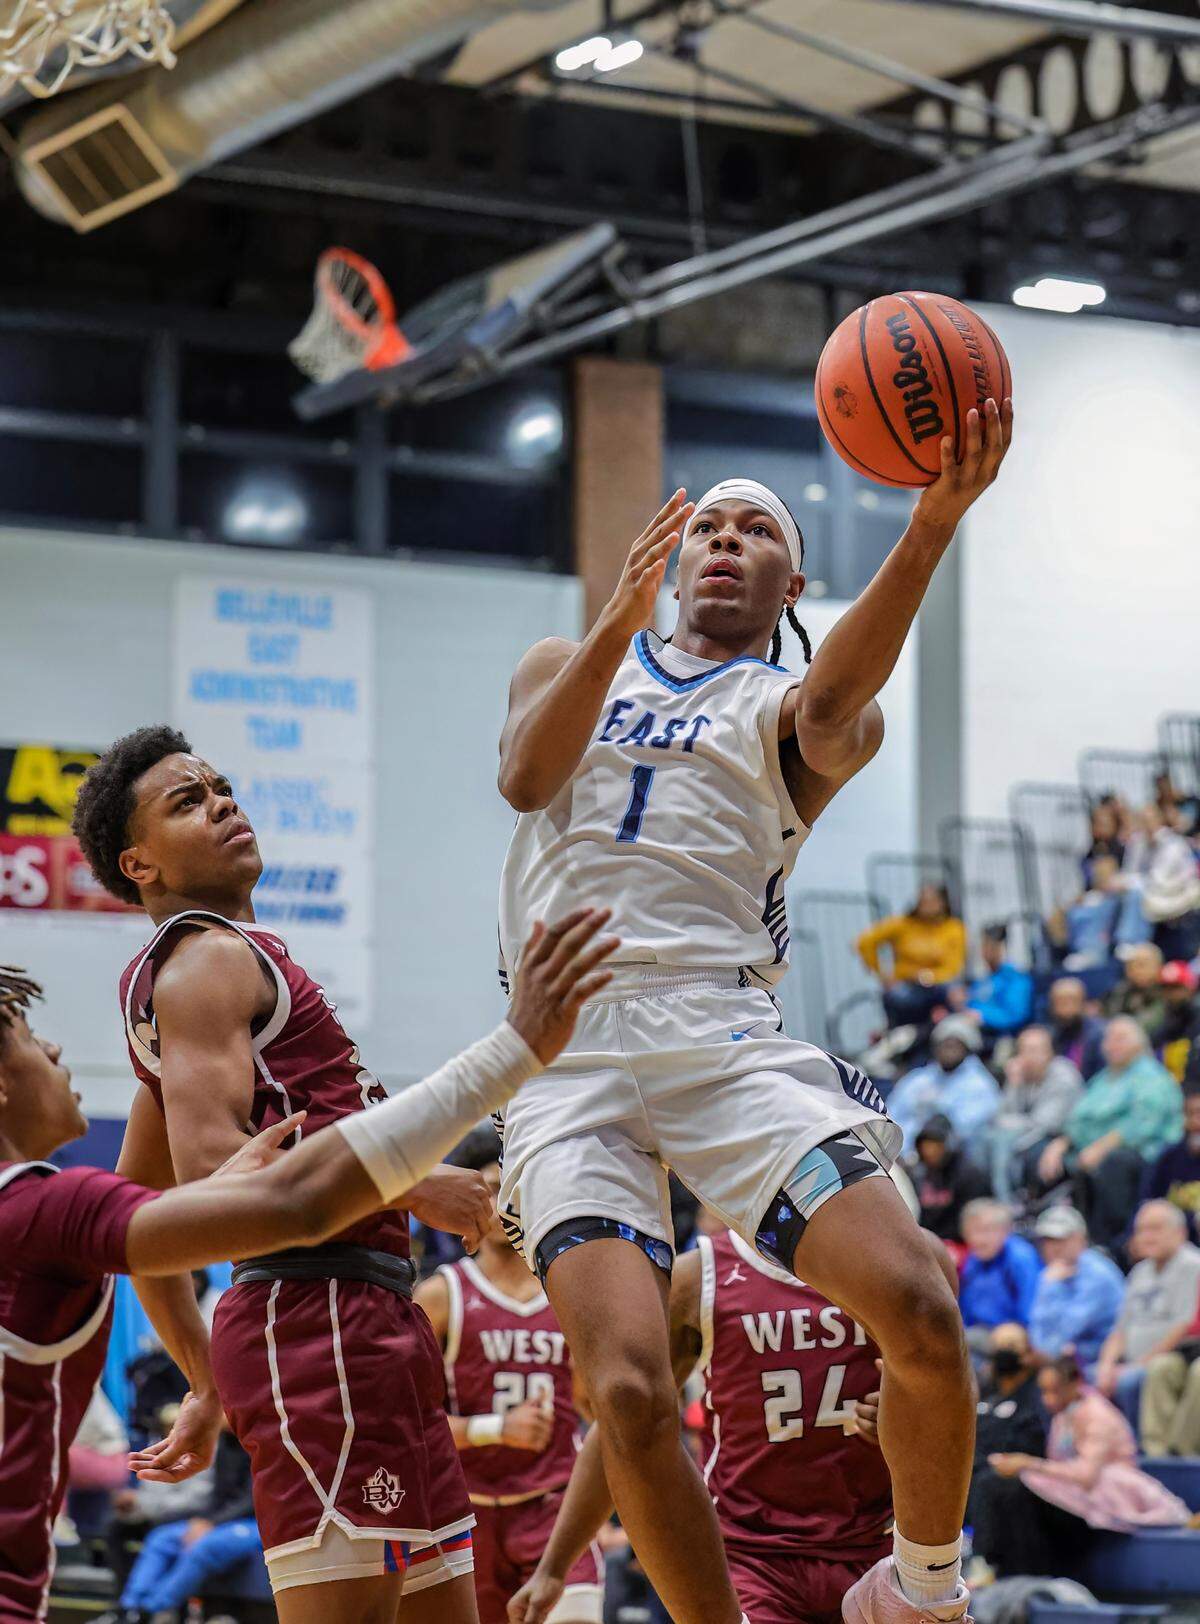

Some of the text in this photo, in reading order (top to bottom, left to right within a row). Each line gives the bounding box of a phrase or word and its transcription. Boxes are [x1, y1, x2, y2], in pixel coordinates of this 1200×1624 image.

[884, 310, 944, 446] Wilson
[598, 699, 712, 753] EAST
[615, 763, 657, 843] 1
[479, 1328, 565, 1366] WEST
[761, 1363, 861, 1443] 24
